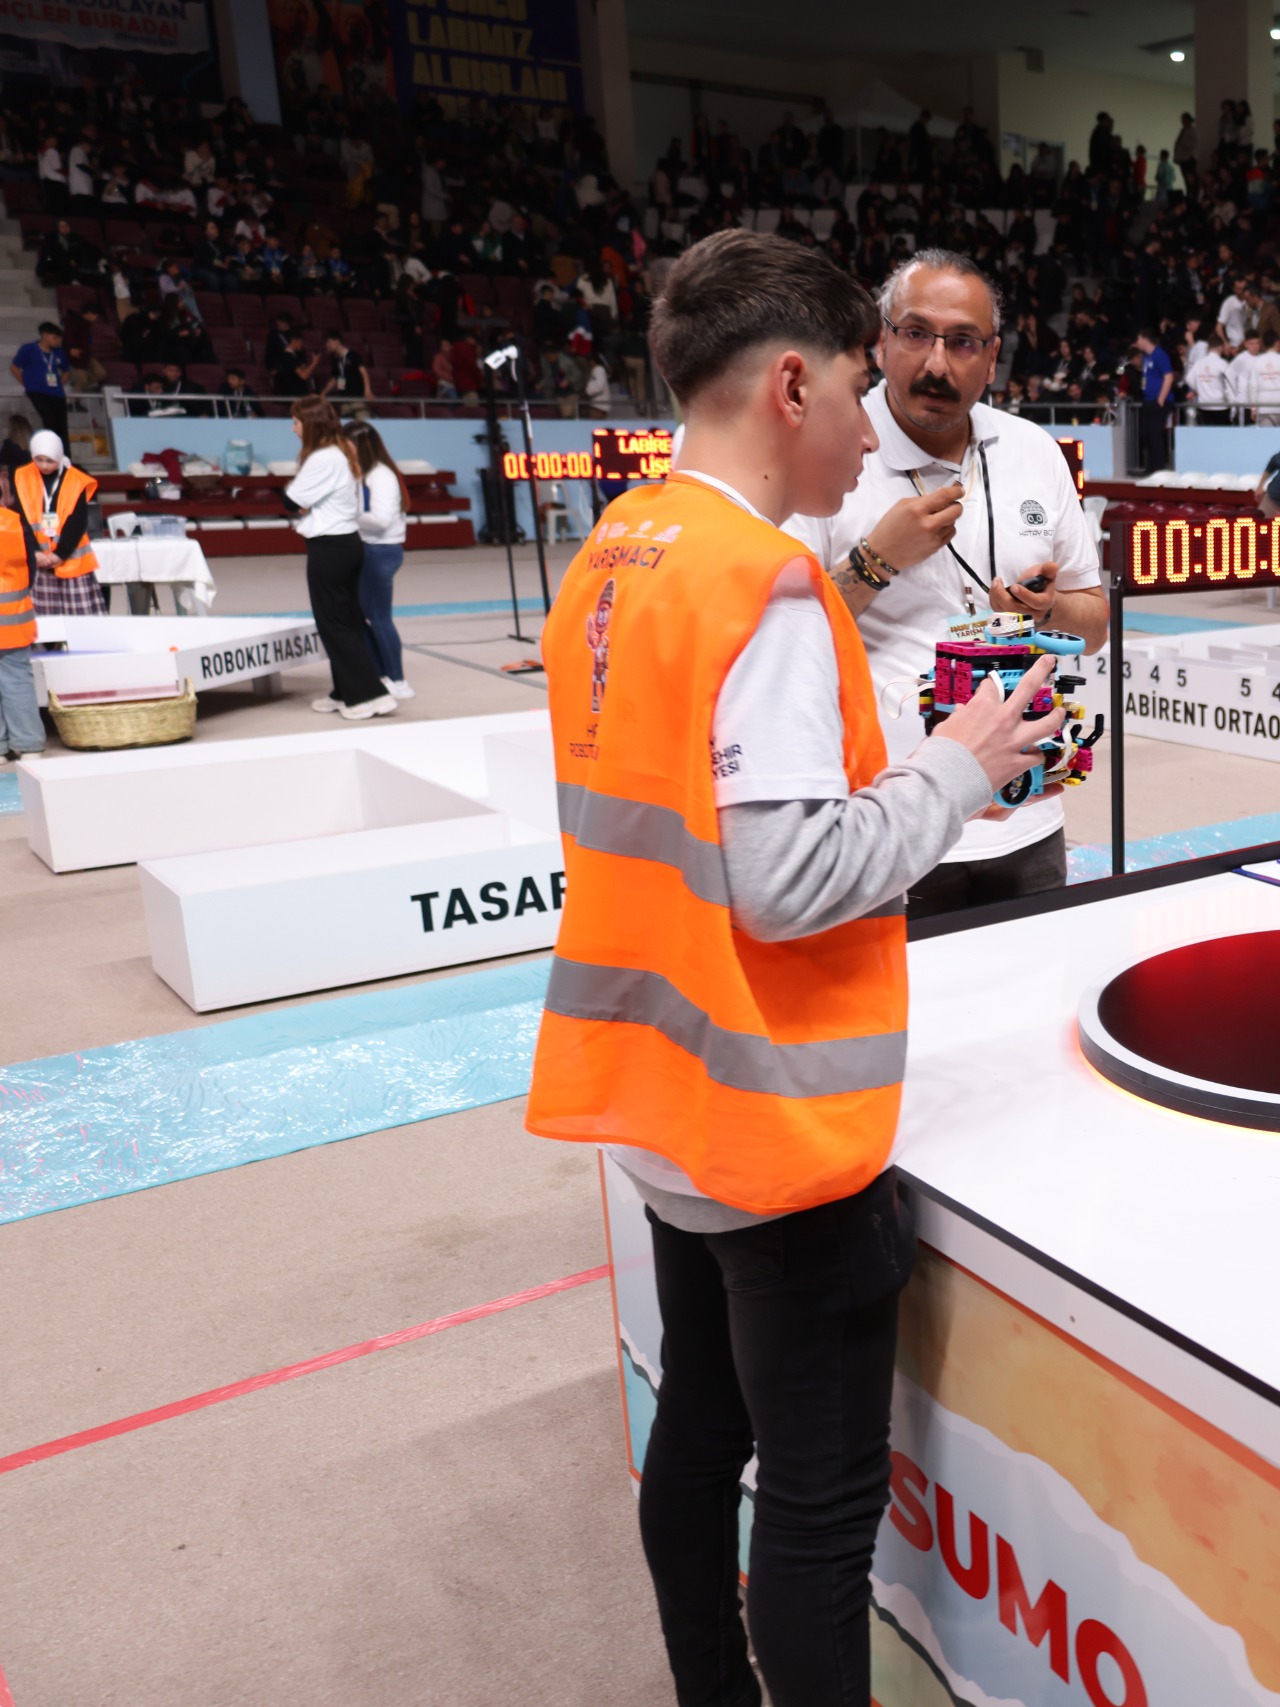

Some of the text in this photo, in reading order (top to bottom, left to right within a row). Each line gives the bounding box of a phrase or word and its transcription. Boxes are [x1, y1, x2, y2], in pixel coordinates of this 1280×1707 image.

[77, 10, 179, 38] BURADA!
[619, 433, 672, 454] LABİRE
[200, 643, 271, 679] ROBOKIZ
[1074, 655, 1187, 687] 1 2 3 4 5
[1240, 678, 1252, 698] 5
[1125, 690, 1208, 727] ABİRENT
[888, 1451, 1149, 1707] SUMO
